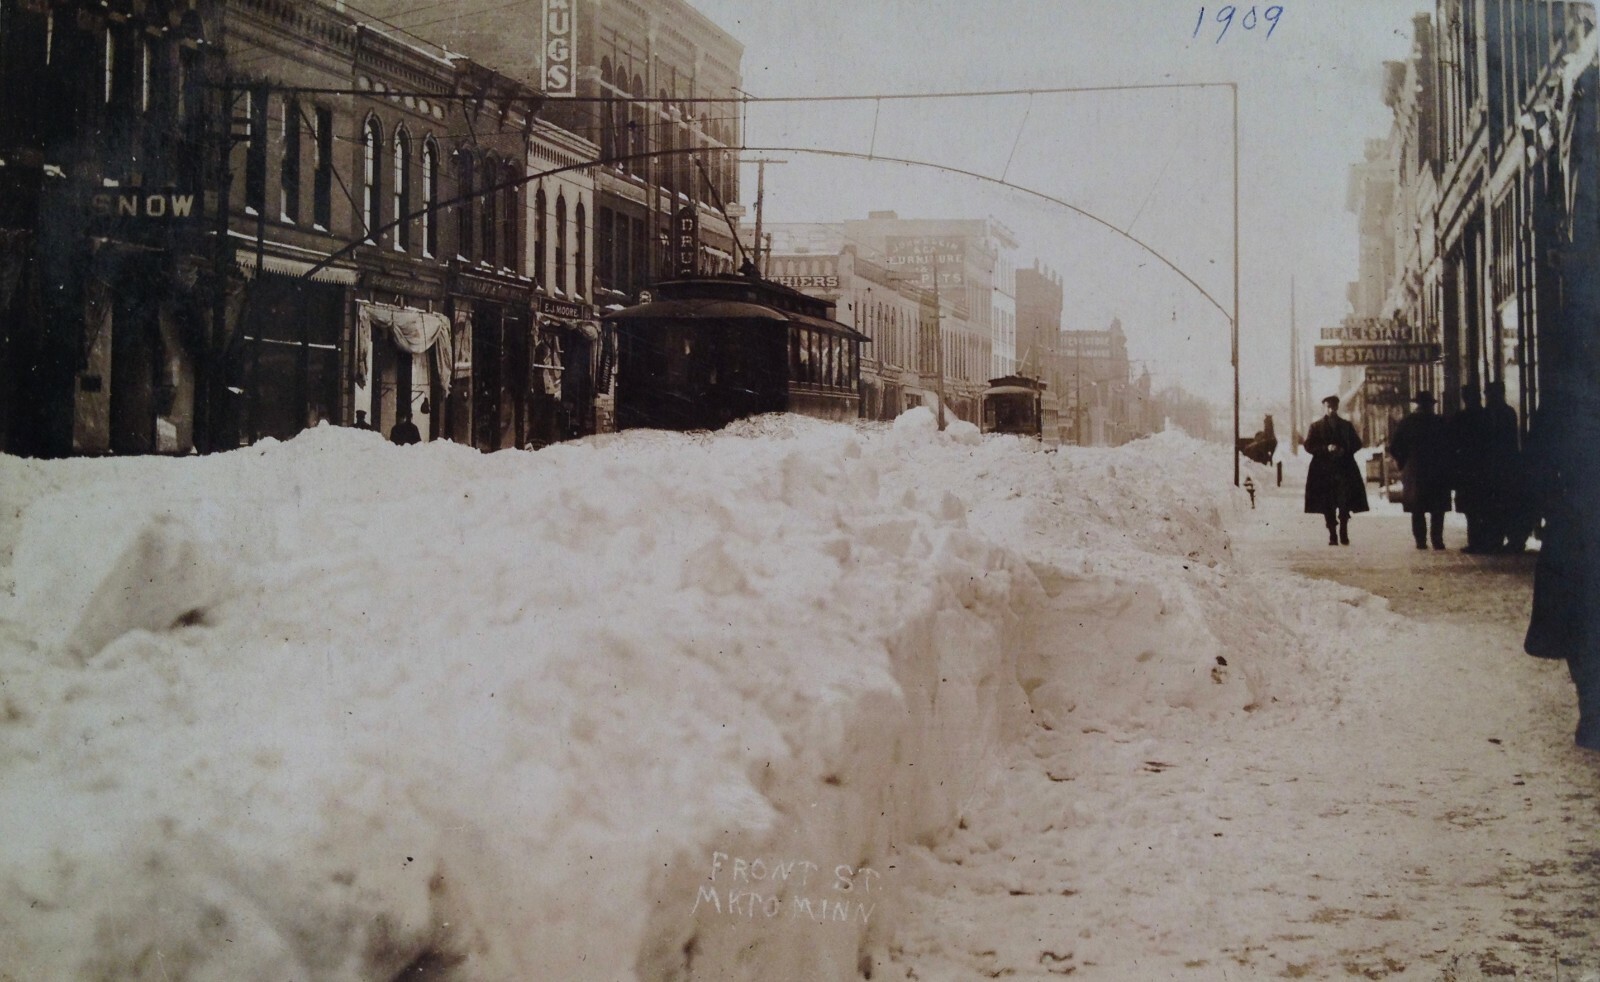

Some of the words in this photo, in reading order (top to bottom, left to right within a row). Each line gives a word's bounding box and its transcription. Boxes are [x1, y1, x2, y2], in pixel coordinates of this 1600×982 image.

[680, 218, 694, 274] DRU
[1361, 327, 1409, 340] ESTATE
[1322, 347, 1431, 363] RESTAURANT
